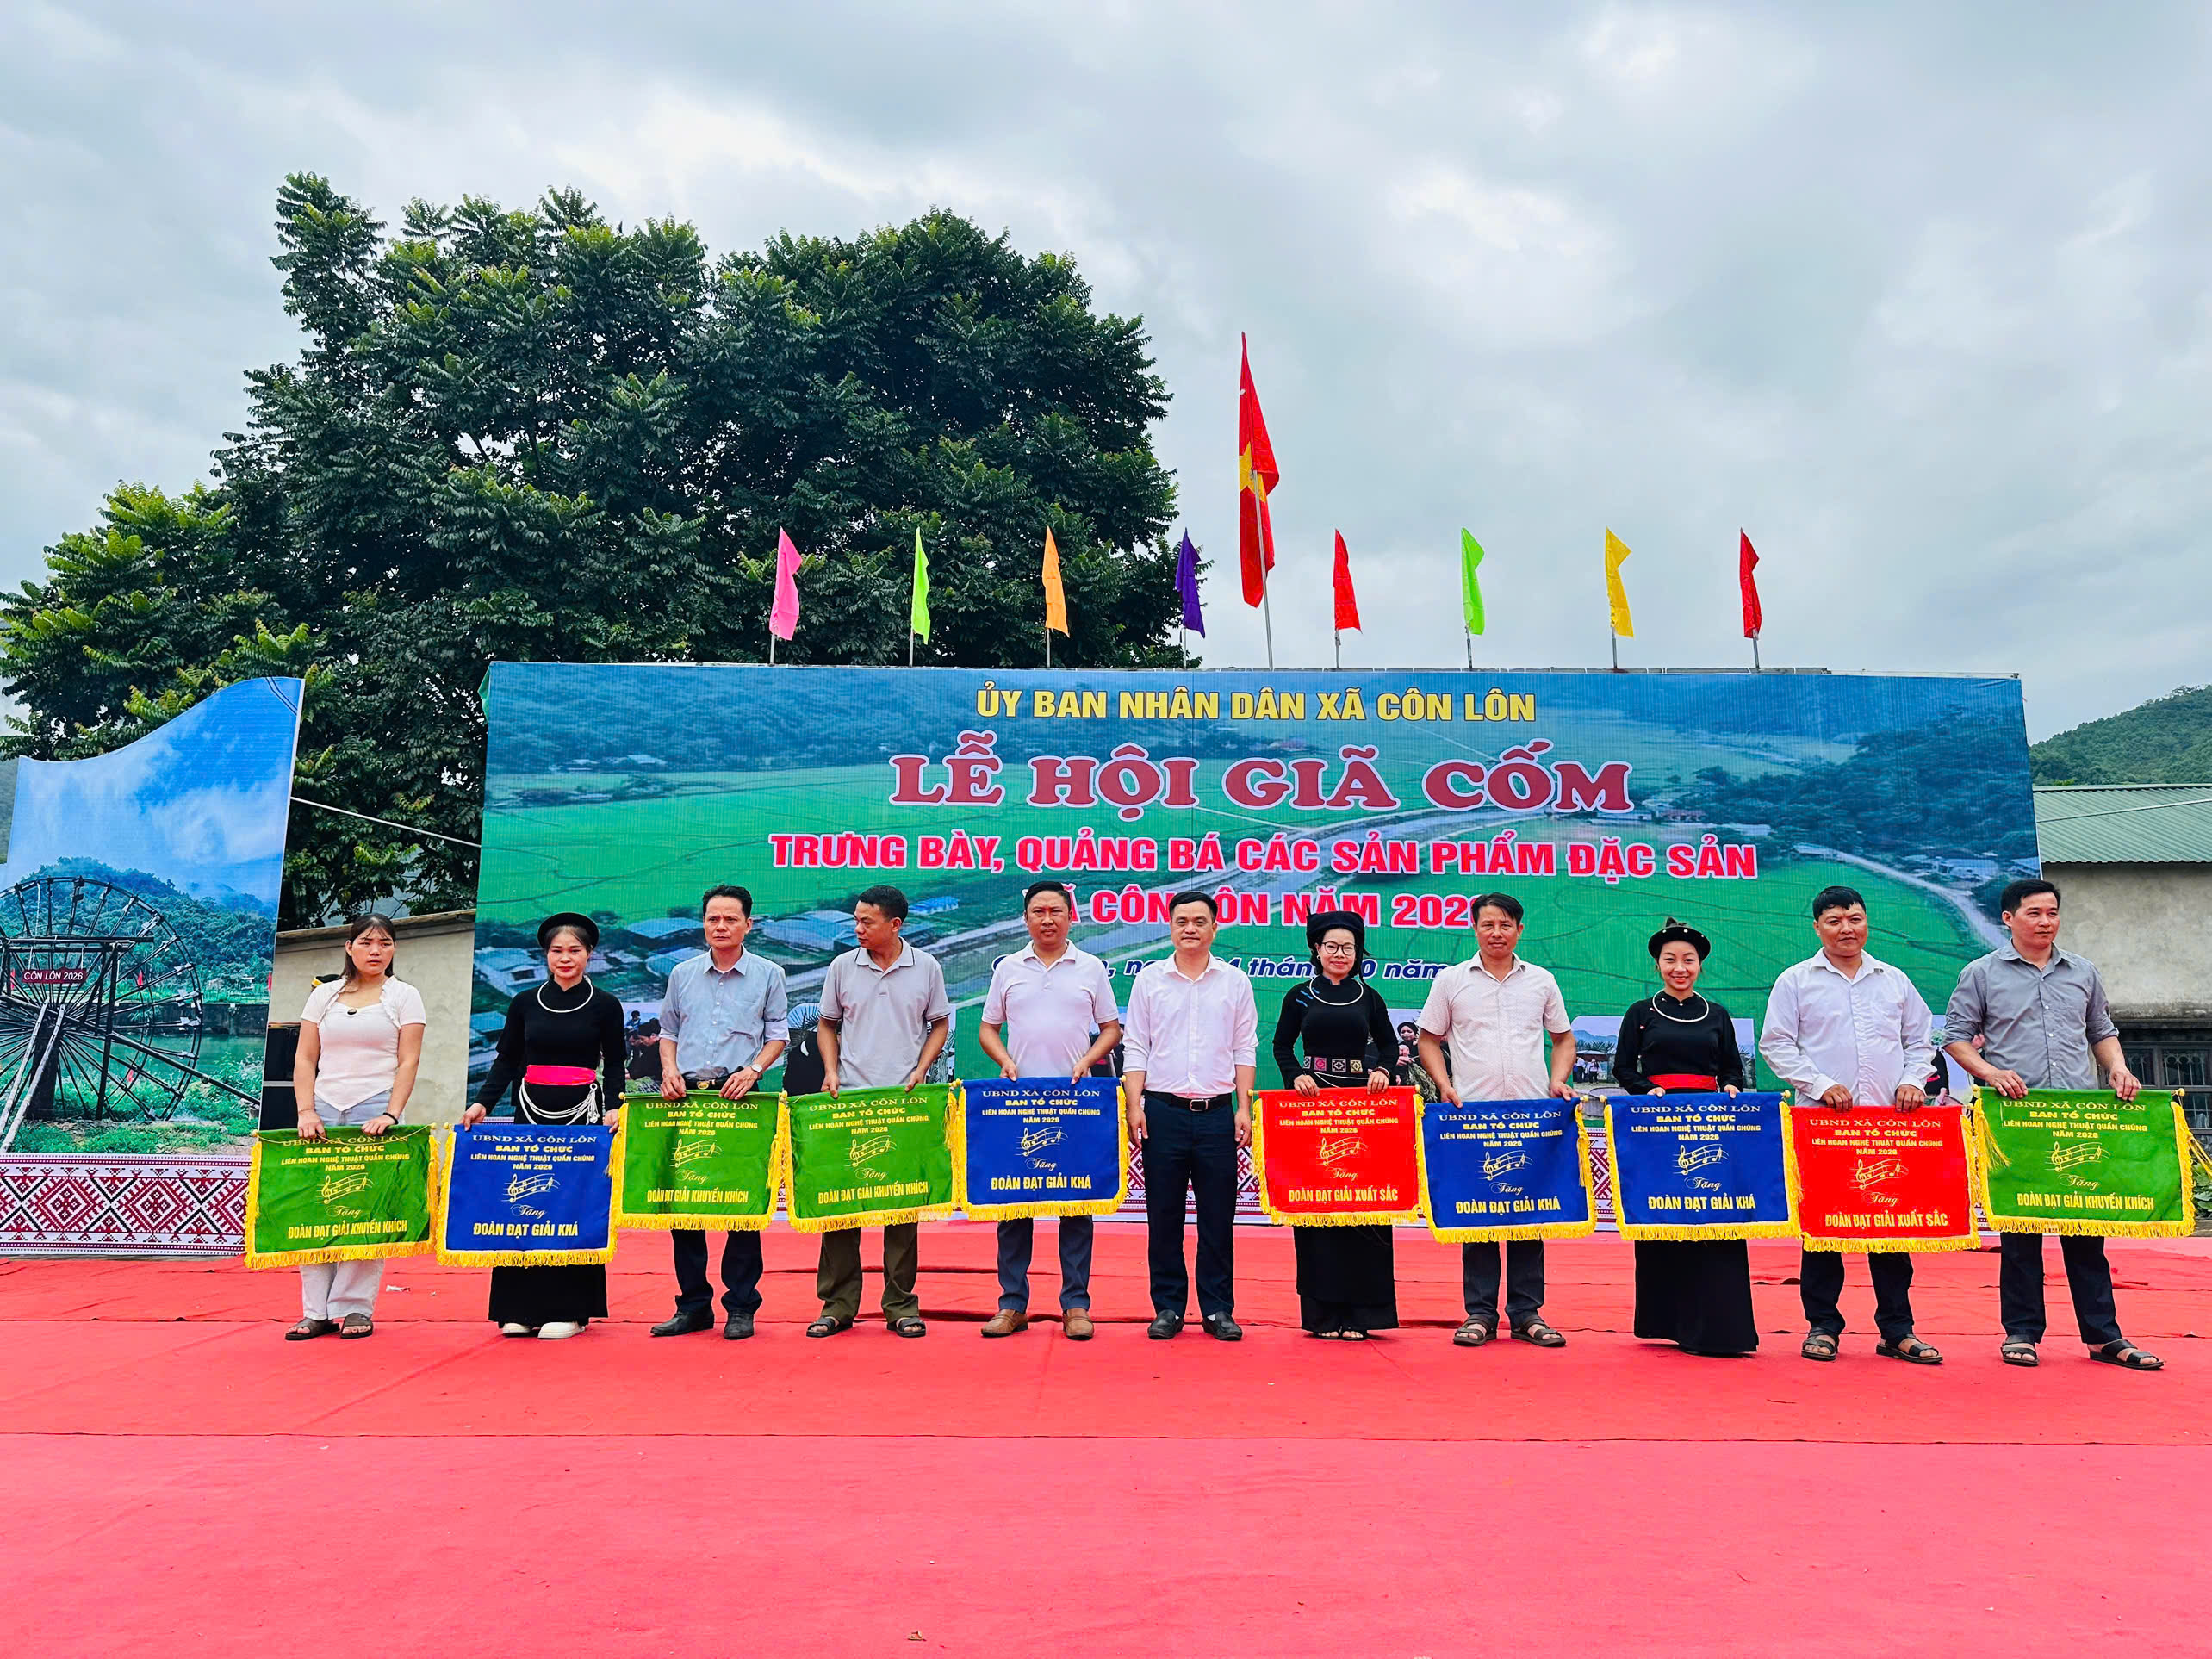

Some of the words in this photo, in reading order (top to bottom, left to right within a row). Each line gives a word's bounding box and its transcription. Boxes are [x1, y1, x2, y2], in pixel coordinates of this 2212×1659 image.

[976, 680, 1022, 718] ỦY
[1034, 690, 1107, 718] BAN
[1119, 686, 1219, 719] NHÂN
[1231, 687, 1306, 720] DÂN
[1316, 687, 1366, 720] XÃ
[1376, 687, 1452, 721] CÔN
[1463, 687, 1536, 722] LÔN
[889, 730, 1005, 806] LỄ
[1026, 742, 1200, 822] HỘI
[1221, 744, 1401, 810] GIÃ
[1422, 738, 1634, 812] CỐM
[768, 831, 907, 869] TRƯNG
[917, 828, 1005, 873] BÀY,
[1015, 827, 1157, 873] QUẢNG
[1168, 831, 1226, 872] BÁ
[1235, 831, 1320, 873] CÁC
[1331, 830, 1420, 874] SẢN
[1430, 829, 1556, 876] PHẨM
[1566, 836, 1656, 885] ĐẶC
[1666, 834, 1758, 879] SẢN
[1090, 884, 1175, 924] CÔN
[1212, 885, 1271, 926] ÔN
[1282, 885, 1381, 927] NĂM
[1391, 892, 1481, 929] 202
[24, 970, 42, 980] CÔN
[45, 970, 61, 980] LÔN
[63, 972, 84, 980] 2026
[1248, 956, 1318, 977] thán
[2084, 1111, 2118, 1120] CHỨC
[2112, 1103, 2146, 1111] LÔN
[991, 1176, 1021, 1190] ĐOÀN
[1023, 1177, 1042, 1191] ĐẠT
[1046, 1172, 1067, 1189] GIẢI
[1071, 1175, 1092, 1189] KHÁ
[1684, 1176, 1722, 1191] Tặng
[674, 1186, 690, 1202] GIẢI
[692, 1184, 724, 1202] KHUYẾN
[725, 1190, 749, 1203] KHÍCH
[818, 1190, 839, 1203] ĐOÀN
[841, 1189, 854, 1202] ĐẠT
[857, 1183, 873, 1200] GIẢI
[874, 1180, 904, 1198] KHUYẾN
[905, 1180, 929, 1195] KHÍCH
[1289, 1187, 1314, 1202] ĐOÀN
[1315, 1190, 1332, 1204] ĐẠT
[1334, 1185, 1352, 1202] GIẢI
[1355, 1185, 1378, 1201] XUẤT
[1380, 1185, 1398, 1201] SẮC
[2017, 1191, 2042, 1206] ĐOÀN
[2044, 1194, 2060, 1209] ĐẠT
[2064, 1191, 2083, 1208] GIẢI
[2085, 1192, 2122, 1209] KHUYẾN
[2125, 1195, 2154, 1210] KHÍCH
[510, 1204, 545, 1219] Tặng
[1456, 1198, 1486, 1214] ĐOÀN
[1489, 1202, 1510, 1215] ĐẠT
[1513, 1196, 1534, 1213] GIẢI
[1538, 1196, 1561, 1210] KHÁ
[1648, 1195, 1681, 1209] ĐOÀN
[1684, 1196, 1706, 1212] ĐẠT
[1711, 1193, 1733, 1209] GIẢI
[1736, 1194, 1755, 1209] KHÁ
[1825, 1212, 1851, 1227] ĐOÀN
[1853, 1215, 1871, 1229] ĐẠT
[1874, 1210, 1895, 1227] GIẢI
[1897, 1209, 1923, 1227] XUẤT
[1926, 1209, 1948, 1227] SẮC
[288, 1224, 312, 1239] ĐOÀN
[314, 1225, 331, 1240] ĐẠT
[332, 1220, 349, 1236] GIẢI
[351, 1219, 381, 1234] KHUYẾN
[383, 1218, 407, 1233] KHÍCH
[474, 1221, 503, 1236] ĐOÀN
[506, 1224, 529, 1238] ĐẠT
[531, 1220, 555, 1236] GIẢI
[557, 1221, 578, 1236] KHÁ
